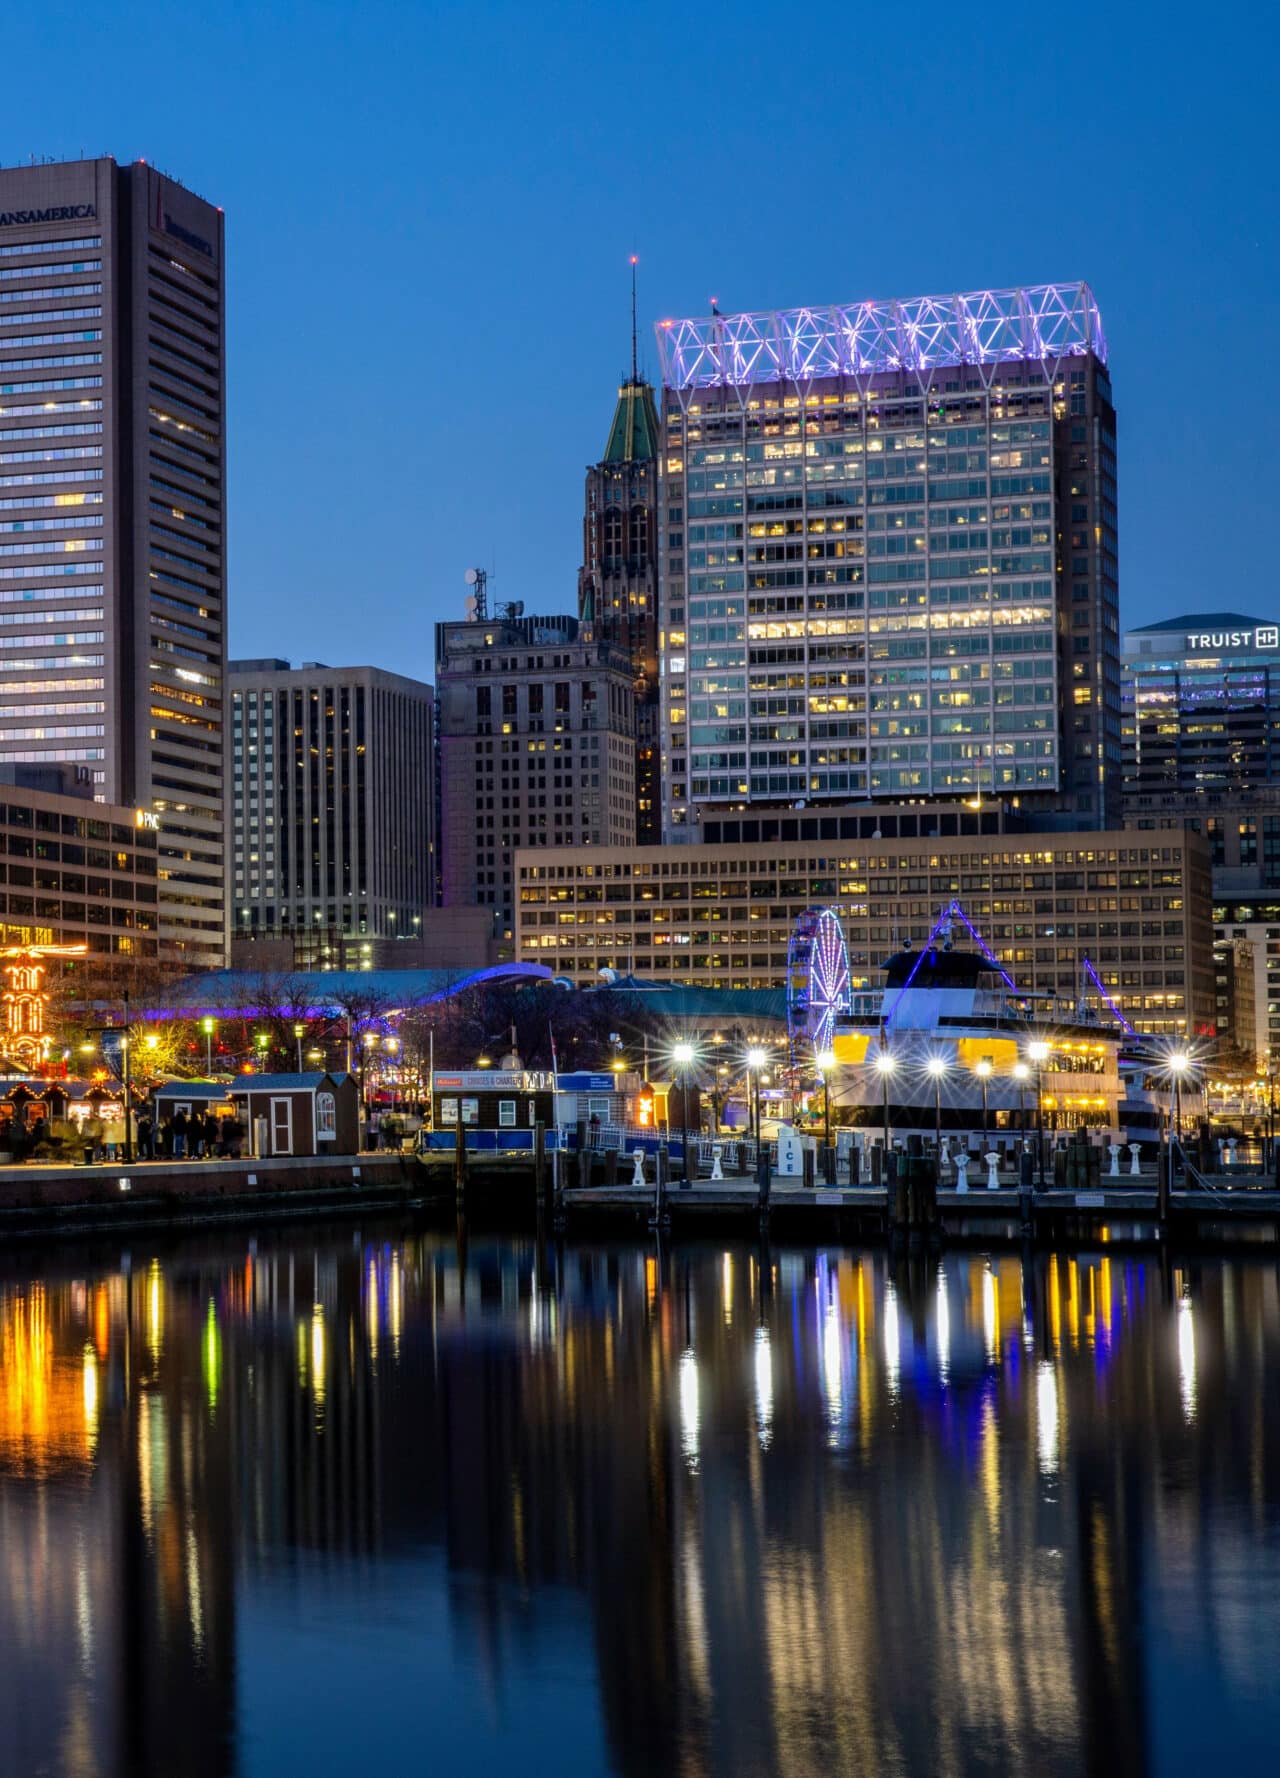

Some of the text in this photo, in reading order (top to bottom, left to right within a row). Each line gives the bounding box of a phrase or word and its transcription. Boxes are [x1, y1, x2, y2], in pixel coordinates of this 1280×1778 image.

[1188, 633, 1251, 648] TRUIST
[144, 812, 159, 829] PNC
[786, 1140, 794, 1172] ICE
